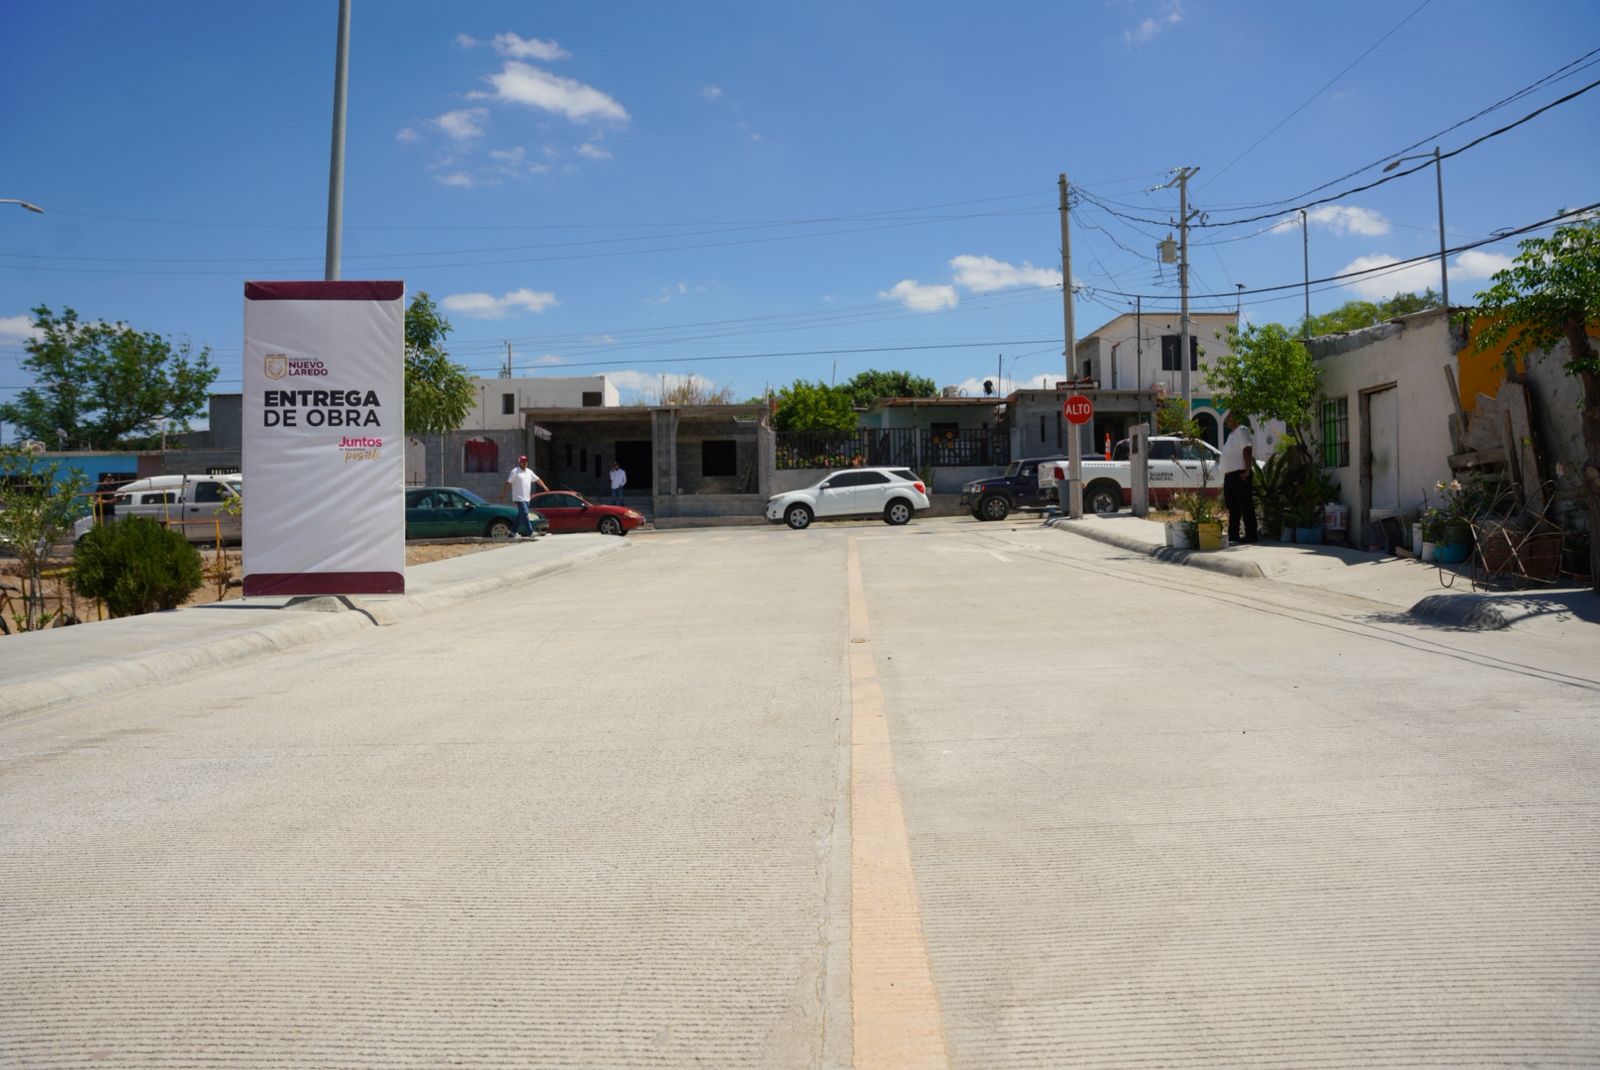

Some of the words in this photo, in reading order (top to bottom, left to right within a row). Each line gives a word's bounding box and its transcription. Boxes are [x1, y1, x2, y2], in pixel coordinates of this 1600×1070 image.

[288, 361, 324, 369] NUEVO
[264, 390, 381, 407] ENTREGA
[1065, 404, 1091, 415] ALTO
[263, 409, 297, 427] DE
[306, 409, 381, 427] OBRA
[338, 436, 383, 447] Juntos
